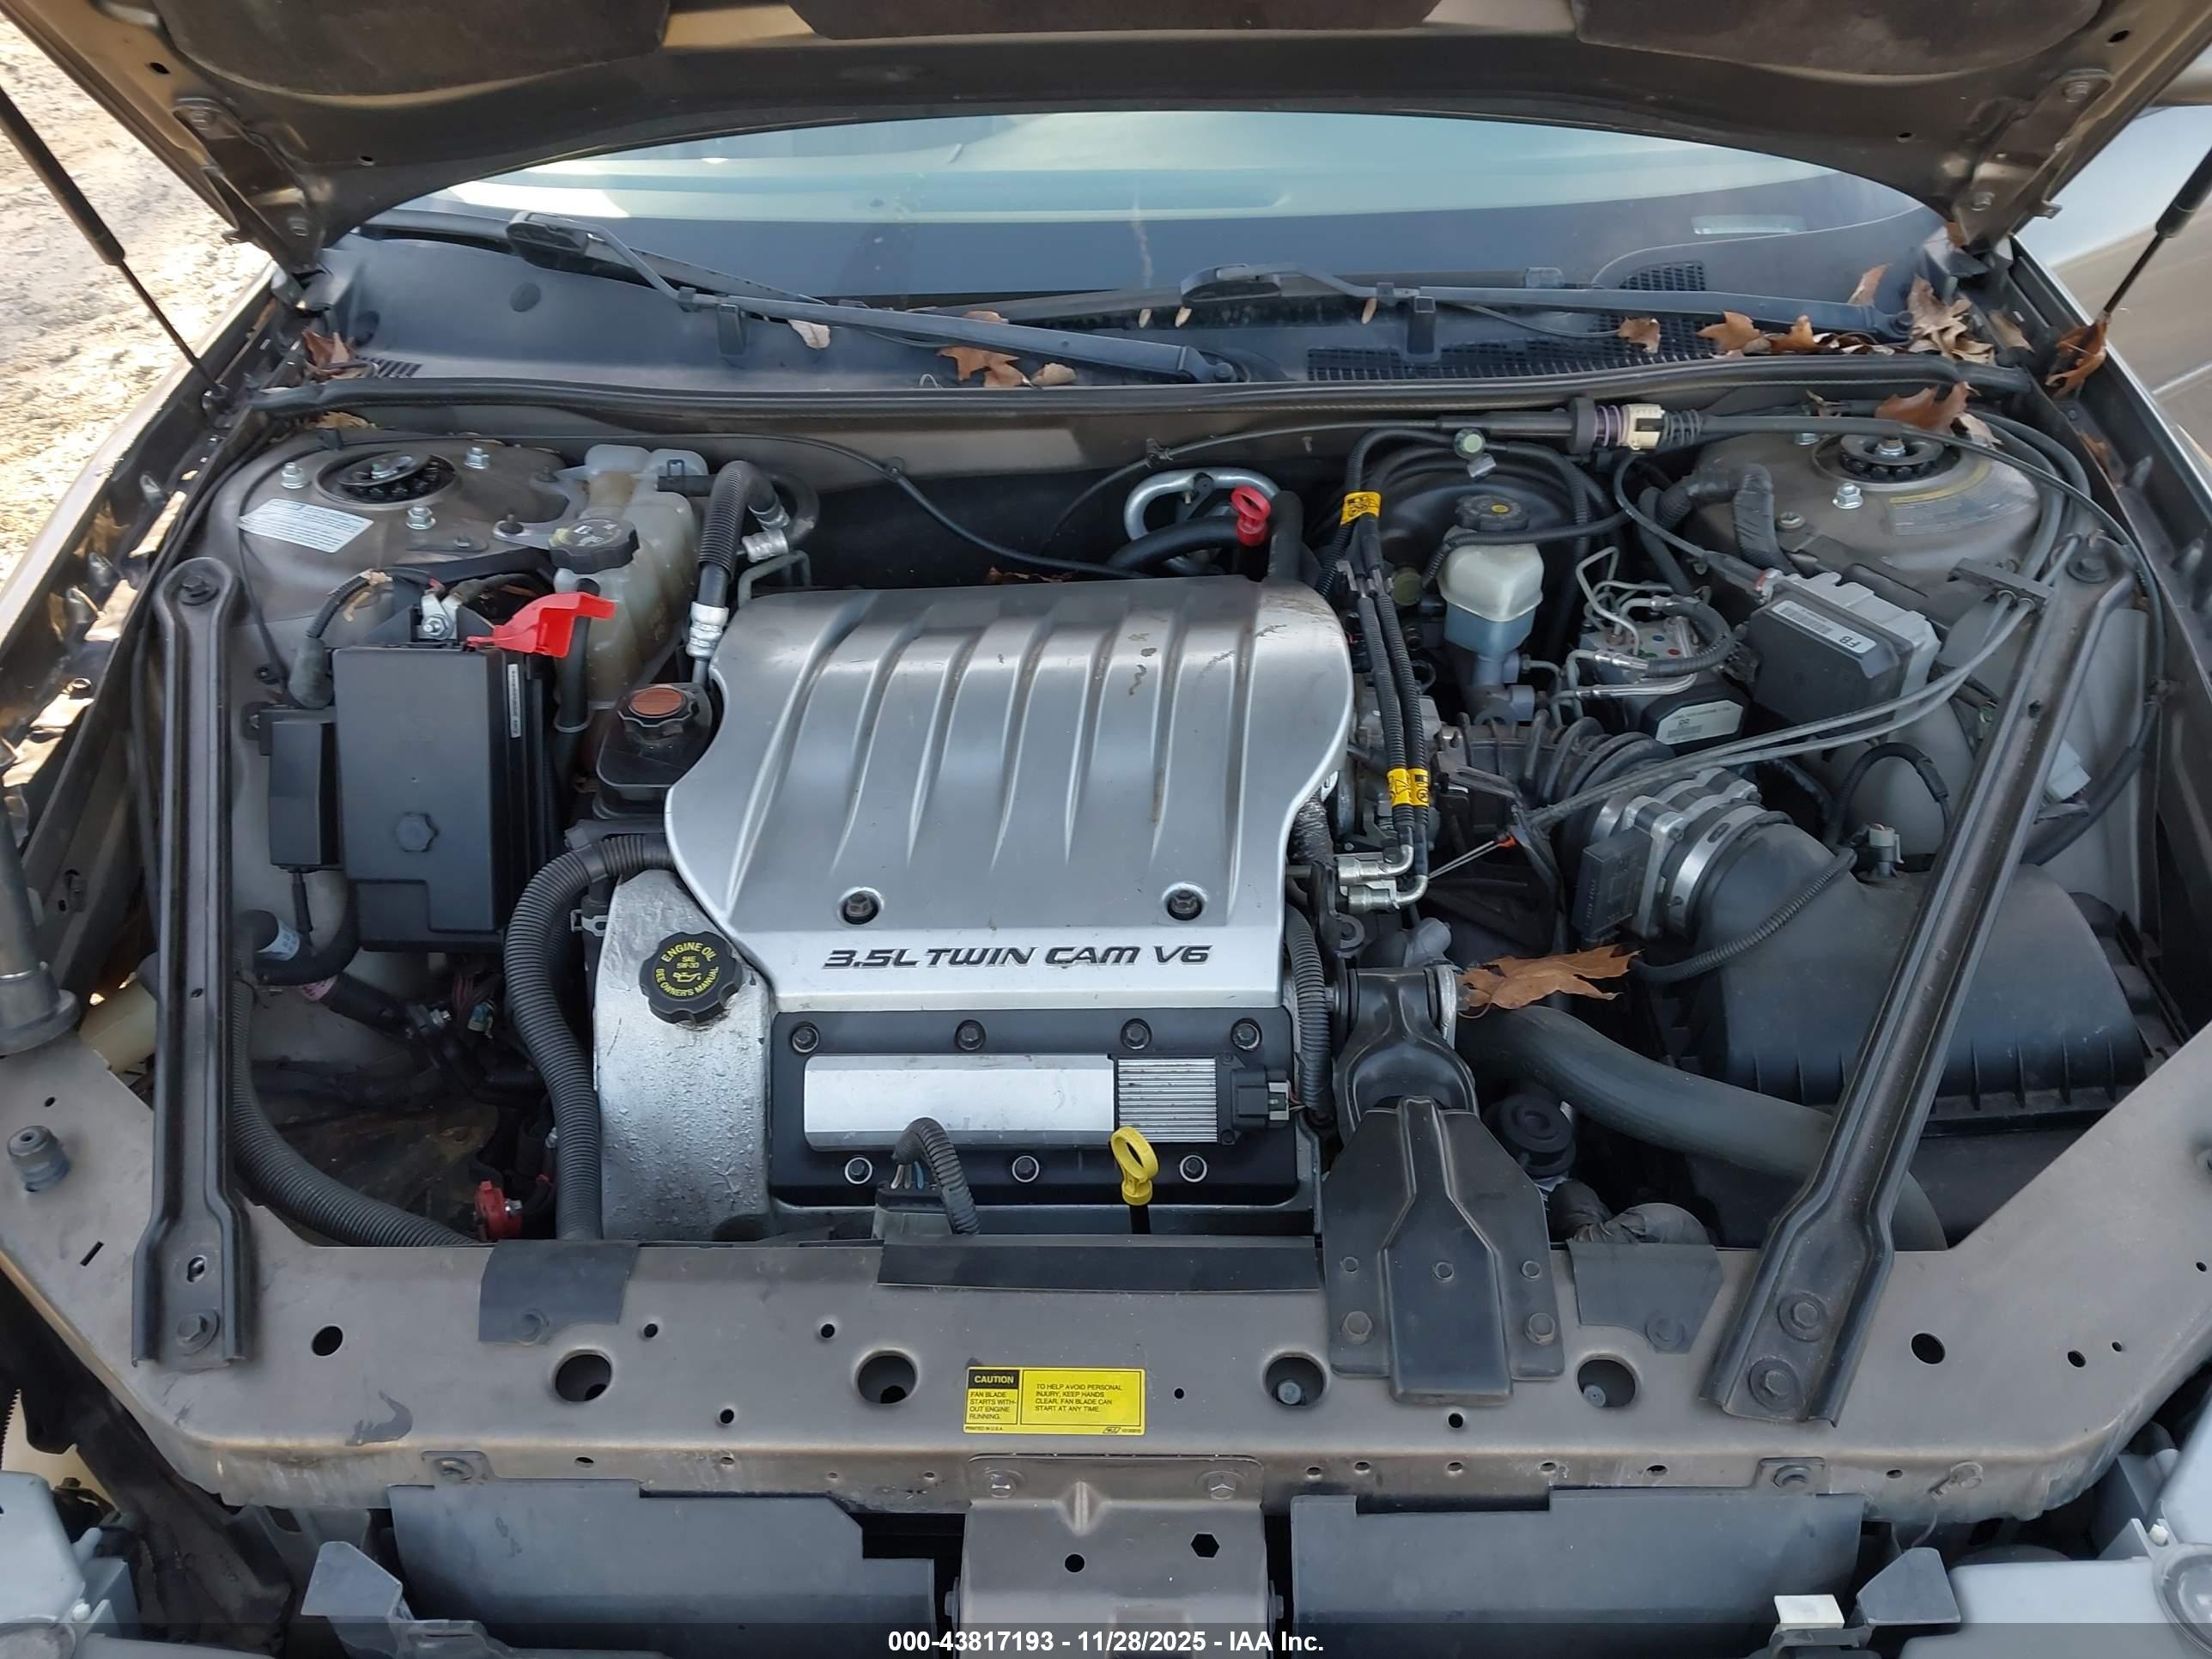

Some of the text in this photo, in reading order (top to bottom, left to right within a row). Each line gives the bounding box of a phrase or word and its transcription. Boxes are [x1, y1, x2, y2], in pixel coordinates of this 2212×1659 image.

[660, 942, 717, 963] ENGINE OIL
[823, 945, 1212, 968] 3.5L TWIN CAM V6
[659, 981, 695, 996] OWNER'S
[694, 966, 720, 993] MANUAL
[974, 1375, 1015, 1383] CAUTION
